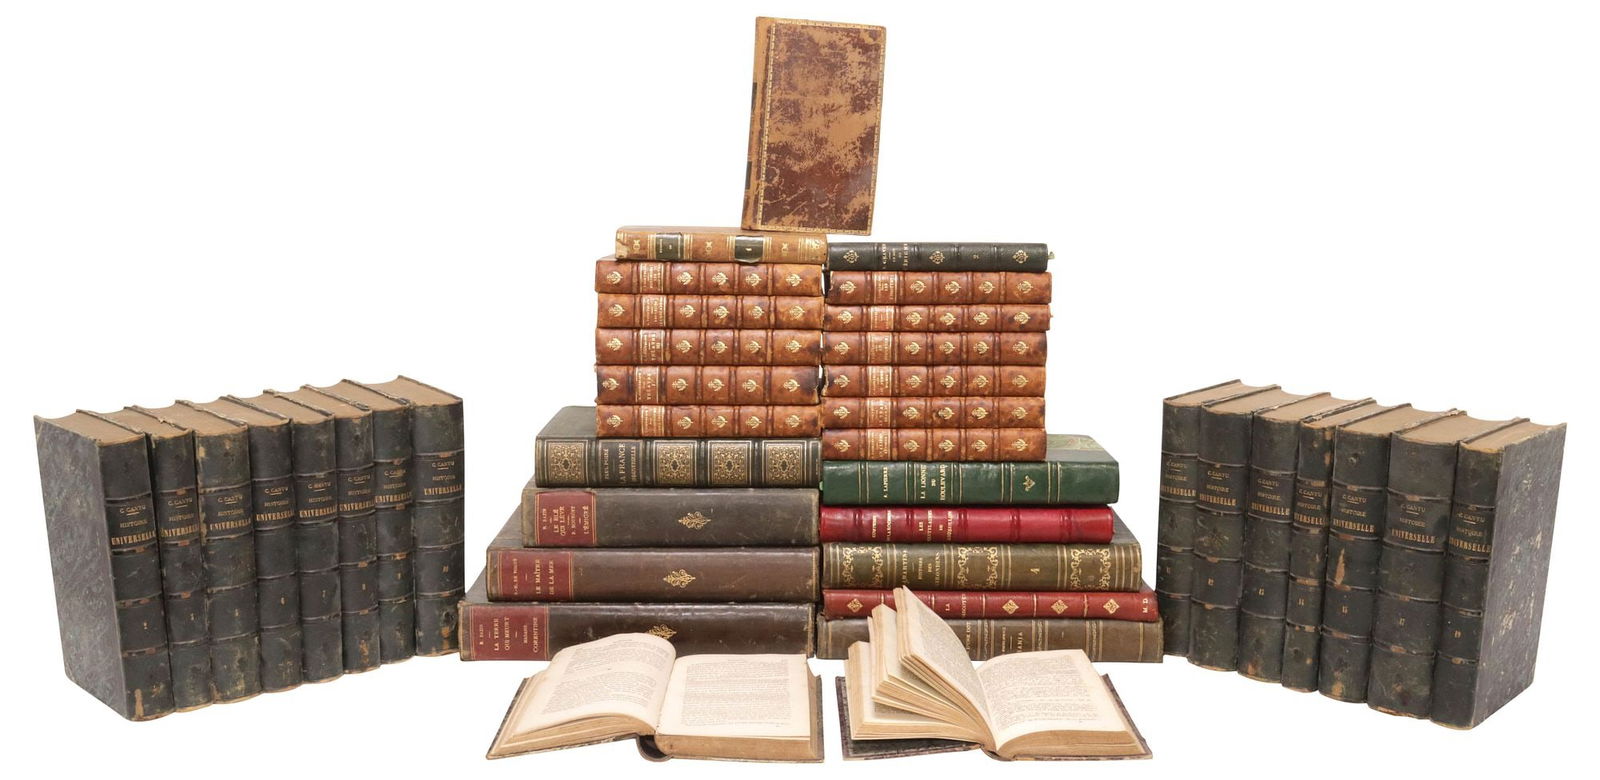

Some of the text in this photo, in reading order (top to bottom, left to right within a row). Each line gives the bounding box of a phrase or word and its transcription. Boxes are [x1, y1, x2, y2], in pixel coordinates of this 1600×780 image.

[618, 442, 626, 474] FRANCE
[424, 484, 464, 496] UNIVERSELLE
[553, 524, 559, 533] LE
[1333, 518, 1376, 533] UNIVERSELLE
[111, 530, 156, 546] UNIVERSELLE
[1391, 528, 1436, 544] UNIVERSELLE
[494, 642, 500, 651] LA
